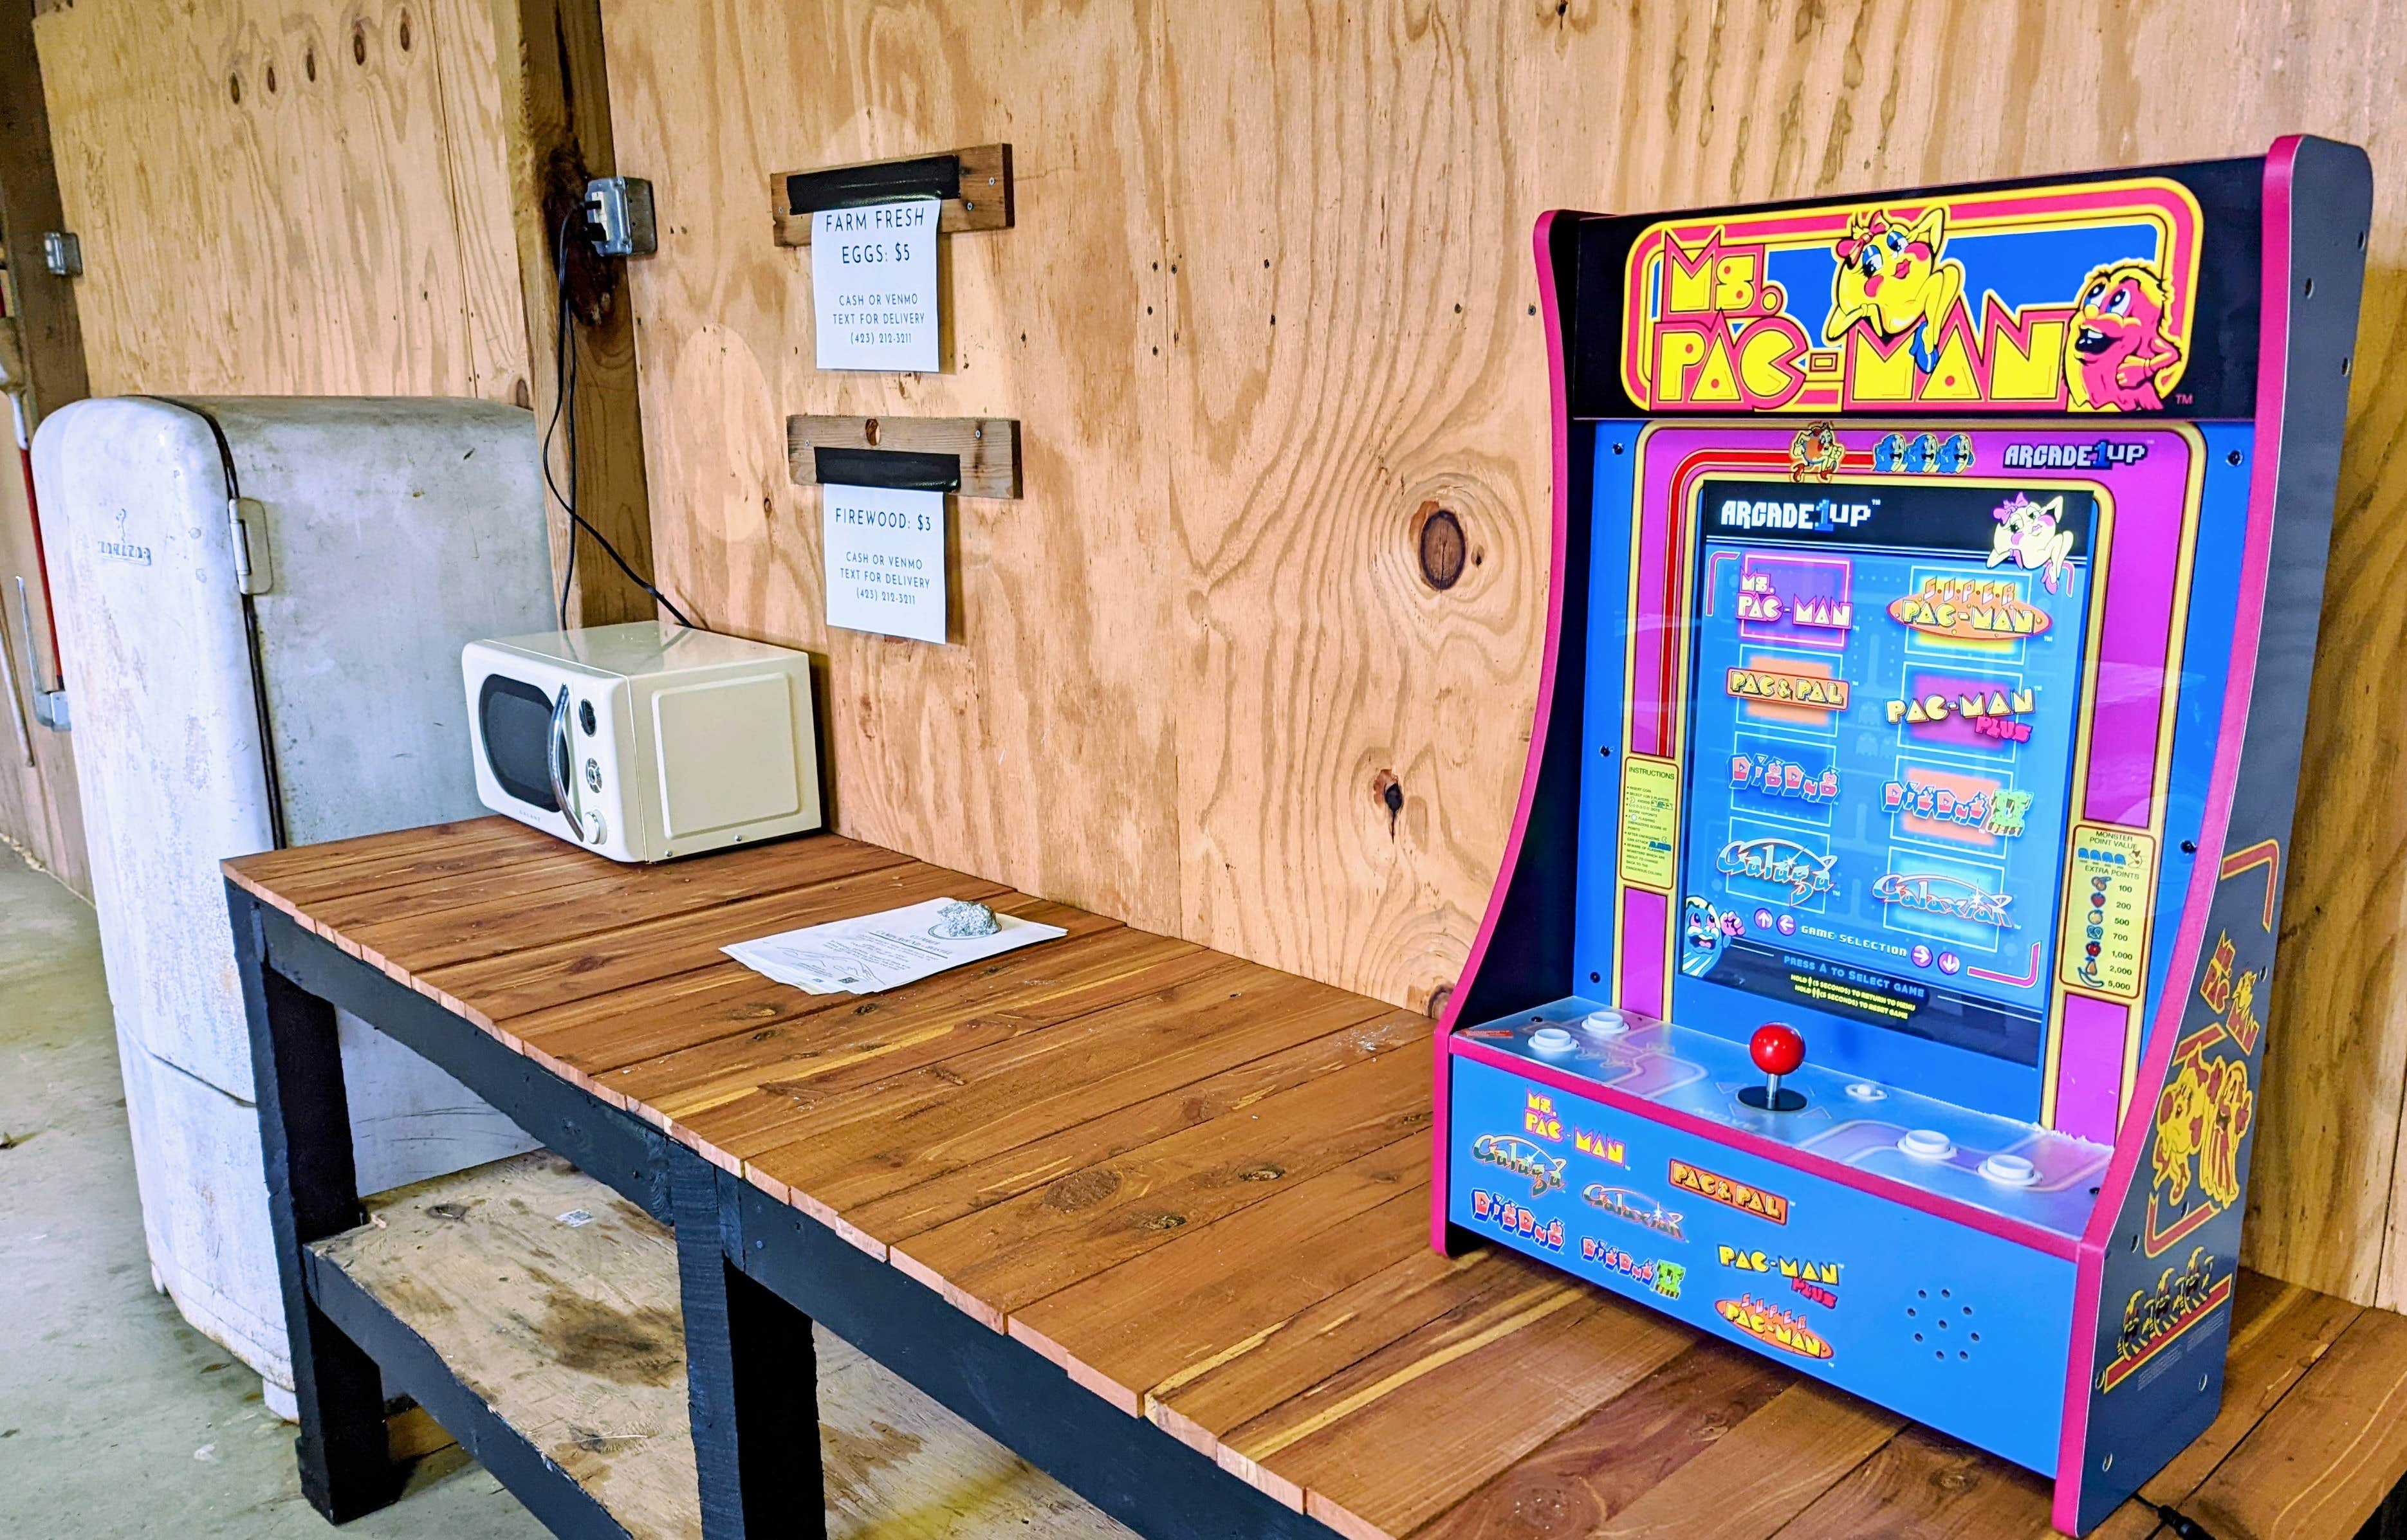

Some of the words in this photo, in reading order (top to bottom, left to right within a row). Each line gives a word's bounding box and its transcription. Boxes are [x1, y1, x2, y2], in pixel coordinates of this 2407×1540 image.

[825, 210, 867, 232] FARM
[876, 207, 925, 228] FRESH
[842, 244, 889, 264] EGGS:
[894, 241, 910, 263] $5
[1664, 228, 1787, 316] MS.
[838, 294, 864, 306] CASH
[869, 294, 882, 306] OR
[885, 293, 918, 305] VENMO
[833, 314, 855, 325] TEXT
[860, 313, 879, 324] FOR
[883, 313, 925, 324] DELIVERY
[850, 331, 874, 345] (423)
[879, 332, 912, 344] 212-3211
[1651, 291, 2073, 410] PAC-MAN
[836, 508, 911, 529] FIREWOOD:
[918, 514, 931, 532] $3
[846, 551, 869, 564] CASH
[872, 555, 885, 565] OR
[889, 556, 923, 570] VENMO
[840, 567, 860, 580] TEXT
[865, 571, 881, 582] FOR
[885, 573, 930, 589] DELIVERY
[1740, 568, 1775, 594] MS.
[856, 587, 878, 601] (423)
[882, 592, 916, 605] 212-3211
[1736, 592, 1853, 629] PAC-MAN
[1902, 600, 2036, 633] PAC-MAN
[1885, 688, 2035, 725] PAC-MAN
[1975, 716, 2034, 743] PLUS
[1629, 766, 1674, 780] INSTRUCTIONS
[2089, 838, 2112, 848] POINT
[2114, 841, 2137, 850] VALUE
[2096, 830, 2133, 842] MONSTER
[1717, 838, 1838, 907] Galaga
[2085, 865, 2109, 875] EXTRA
[2111, 870, 2139, 879] POINTS
[1871, 874, 2013, 928] Galaxian
[2116, 902, 2131, 910] 200
[2114, 918, 2130, 926] 500
[1801, 925, 1834, 940] GAME
[1840, 933, 1907, 957] SELECTION
[2113, 933, 2128, 942] 700
[2112, 951, 2133, 960] 1,000
[1784, 955, 1815, 970] PRESS
[1820, 963, 1827, 973] A
[1832, 967, 1845, 977] TO
[1849, 971, 1890, 989] SELECT
[1894, 984, 1924, 998] GAME
[2109, 966, 2132, 975] 2,000
[1791, 974, 1807, 984] HOLD
[1820, 982, 1850, 995] SECONDS)
[1861, 991, 1886, 1004] RETURN
[1886, 998, 1895, 1007] TO
[1896, 1000, 1915, 1011] MENU
[2108, 980, 2130, 991] 5,000
[1794, 985, 1811, 994] HOLD
[1827, 993, 1858, 1007] SECONDS)
[1868, 1004, 1888, 1014] RESET
[1889, 1009, 1908, 1020] GAME
[1526, 1085, 1556, 1117] MS.
[1473, 1134, 1566, 1198] Galaga
[1582, 1184, 1685, 1241] Galaxian
[1718, 1245, 1840, 1285] PAC-MAN
[1791, 1278, 1838, 1309] PLUS
[1724, 1301, 1822, 1358] PAC-MAN
